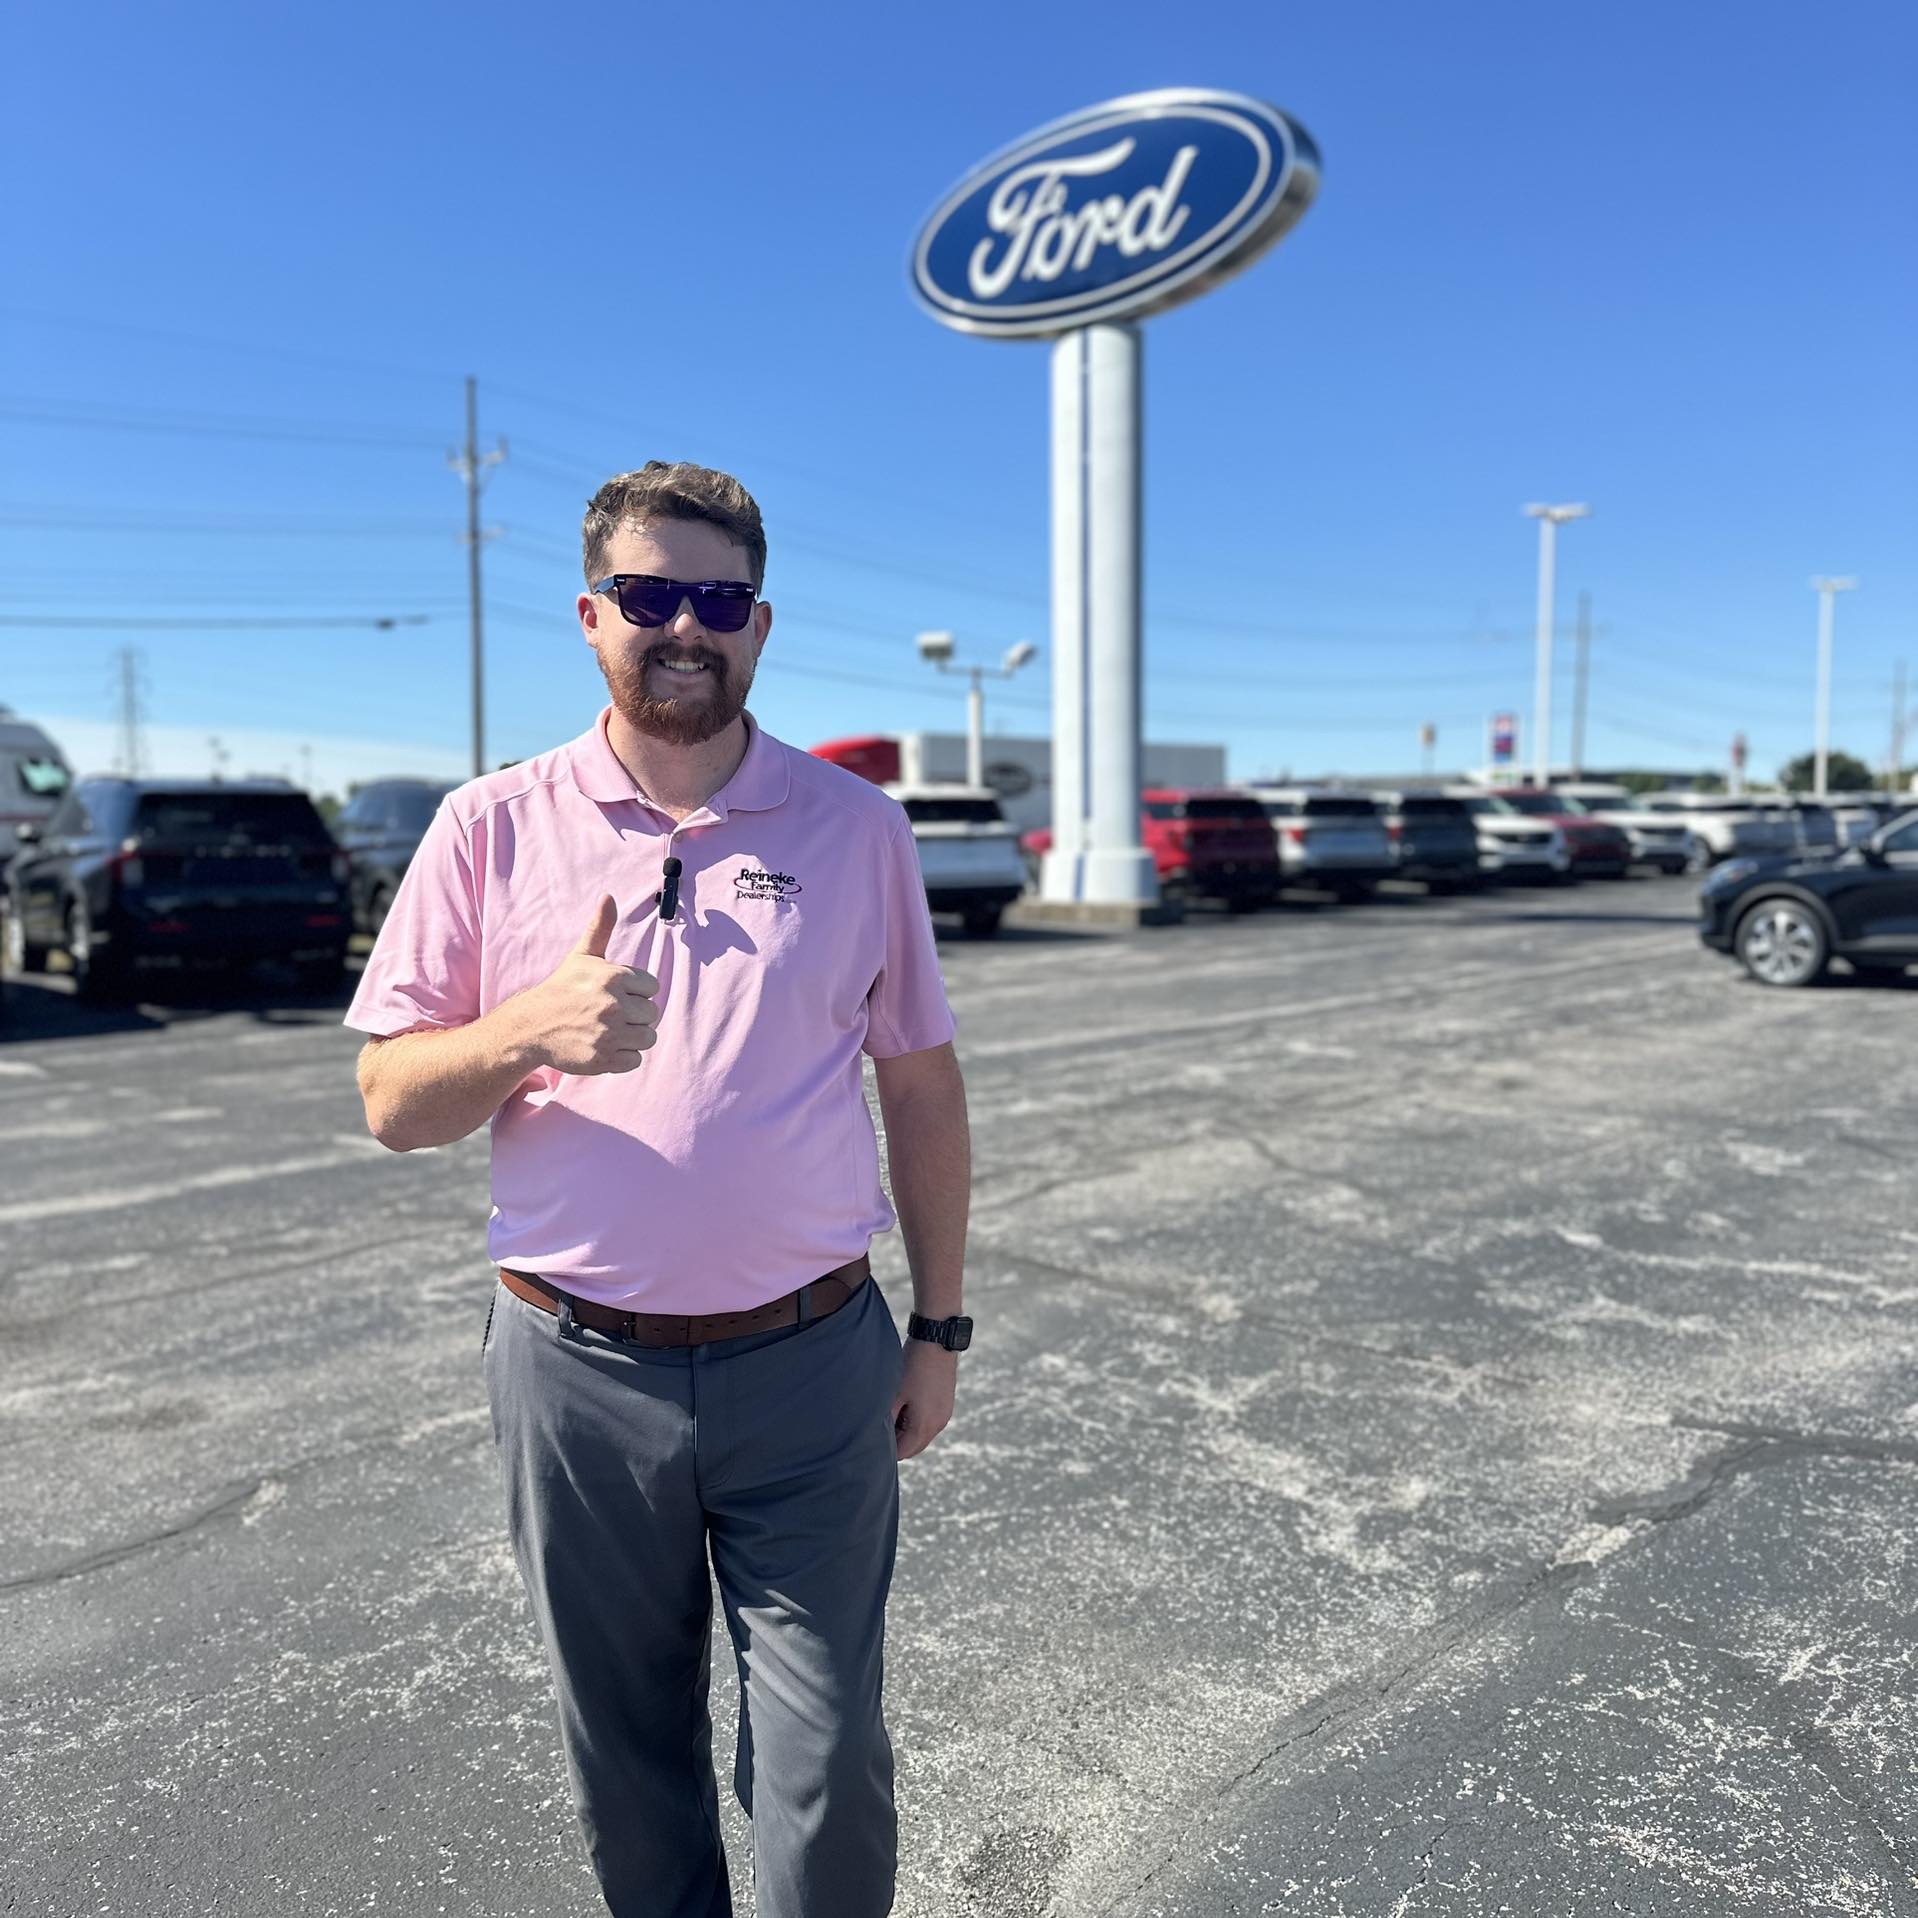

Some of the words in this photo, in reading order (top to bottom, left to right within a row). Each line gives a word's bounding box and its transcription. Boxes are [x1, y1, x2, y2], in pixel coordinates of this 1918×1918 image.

[968, 136, 1198, 299] Ford
[740, 868, 796, 886] Reineke
[751, 881, 785, 894] Family
[736, 890, 785, 903] Dealerships
